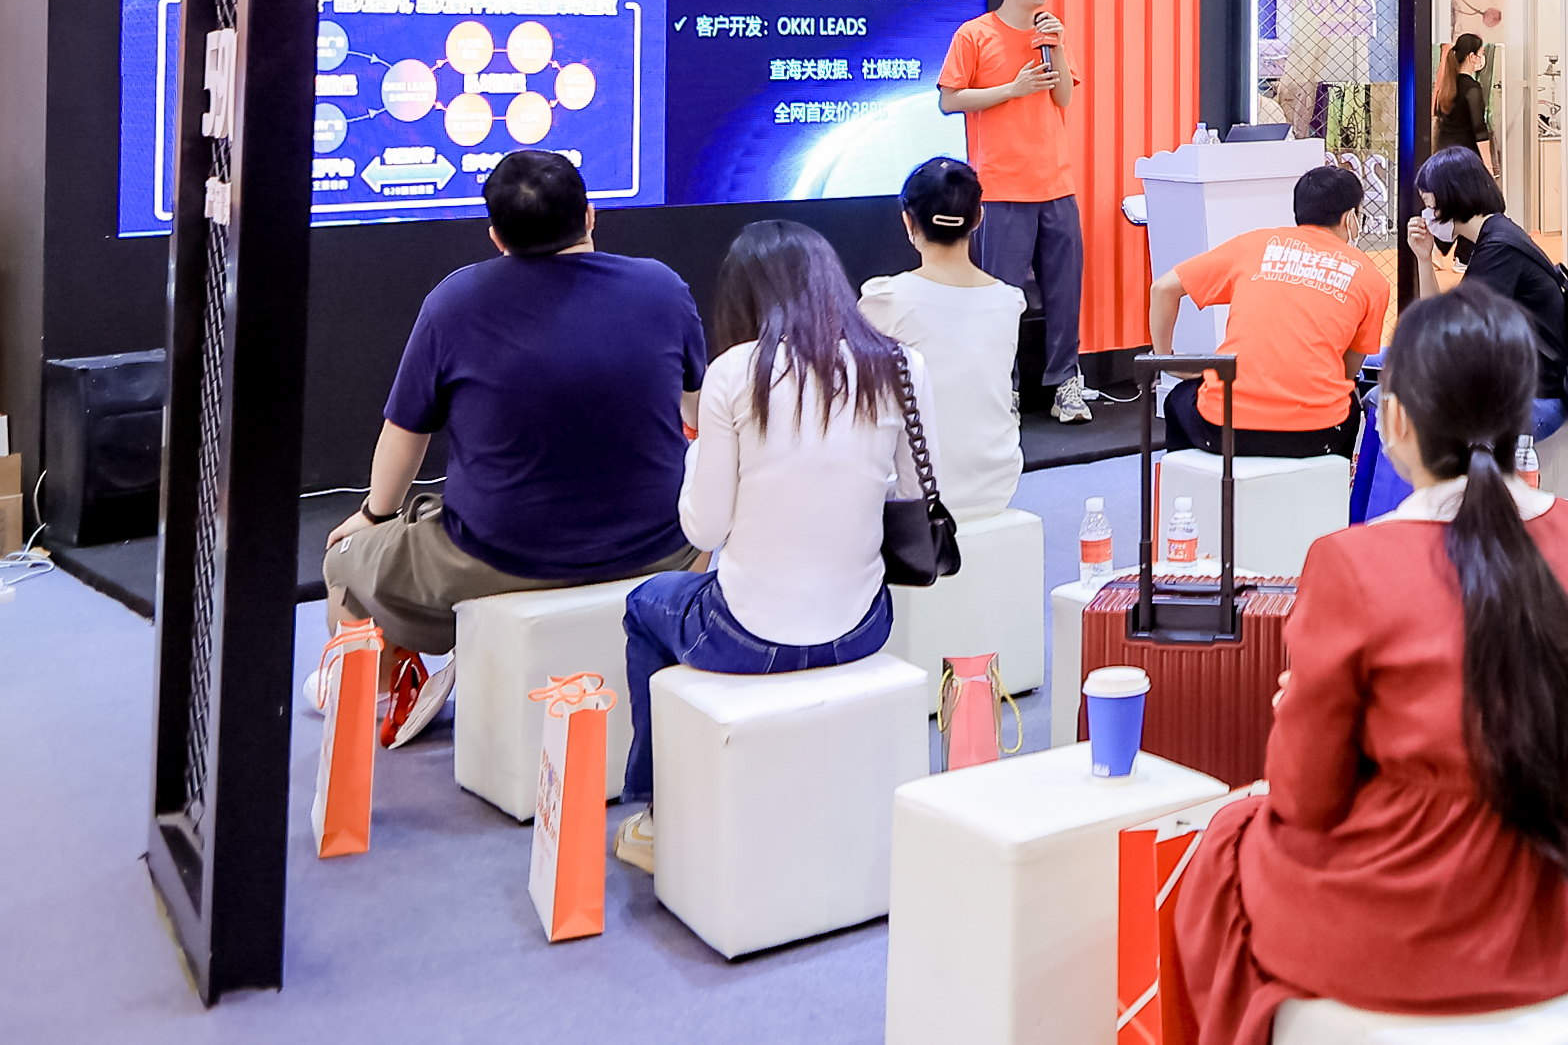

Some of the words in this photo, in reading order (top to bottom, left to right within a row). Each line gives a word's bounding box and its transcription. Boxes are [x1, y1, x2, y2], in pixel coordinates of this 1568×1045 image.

[819, 18, 867, 37] LEADS
[769, 58, 921, 81] 查海关数据、社媒获客
